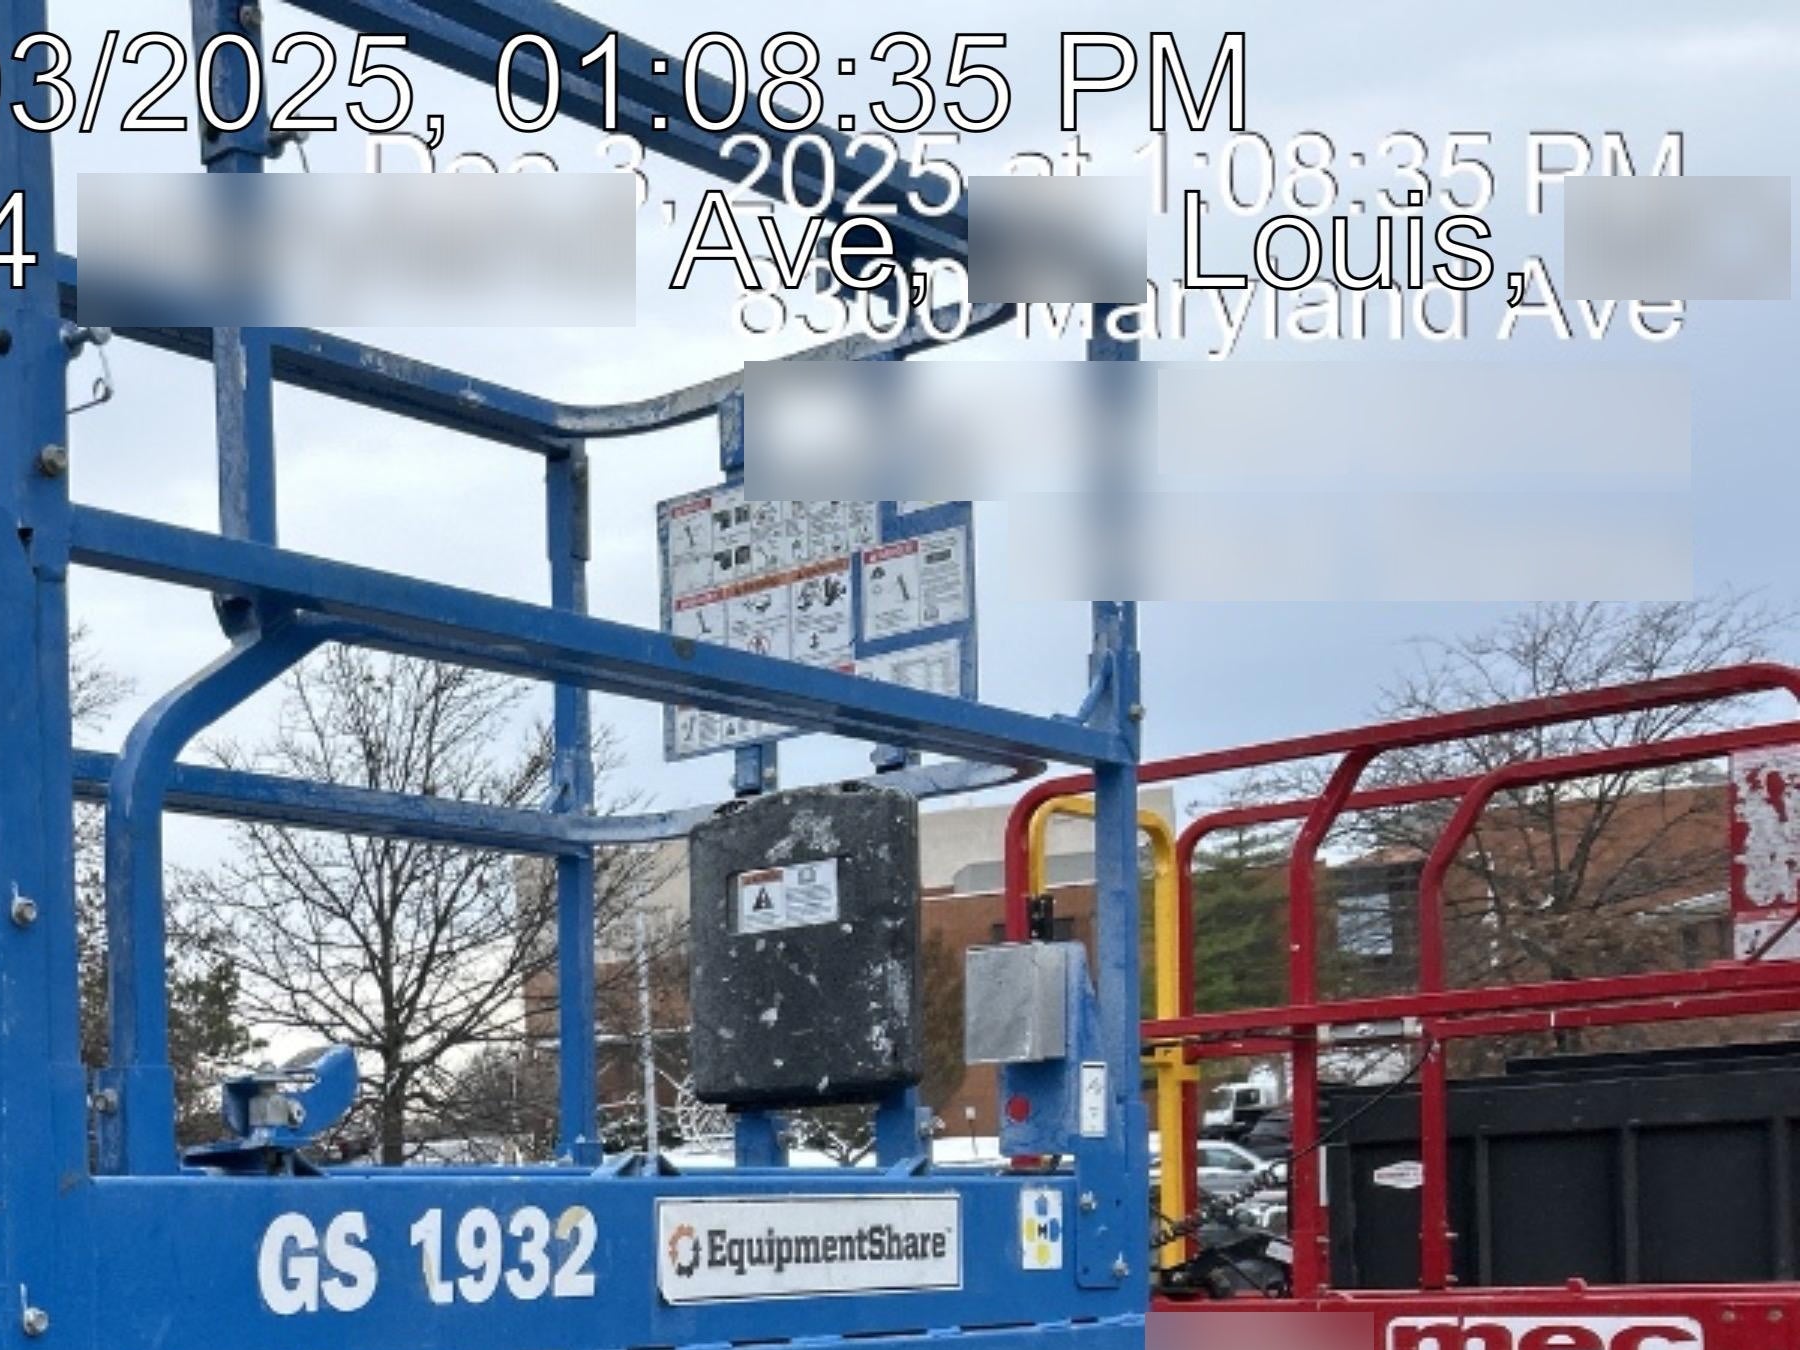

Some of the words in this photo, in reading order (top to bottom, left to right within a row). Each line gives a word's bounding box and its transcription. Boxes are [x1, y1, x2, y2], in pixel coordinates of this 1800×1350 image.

[257, 1211, 379, 1315] GS
[410, 1204, 598, 1304] 1932
[707, 1223, 947, 1276] EquipmentShare
